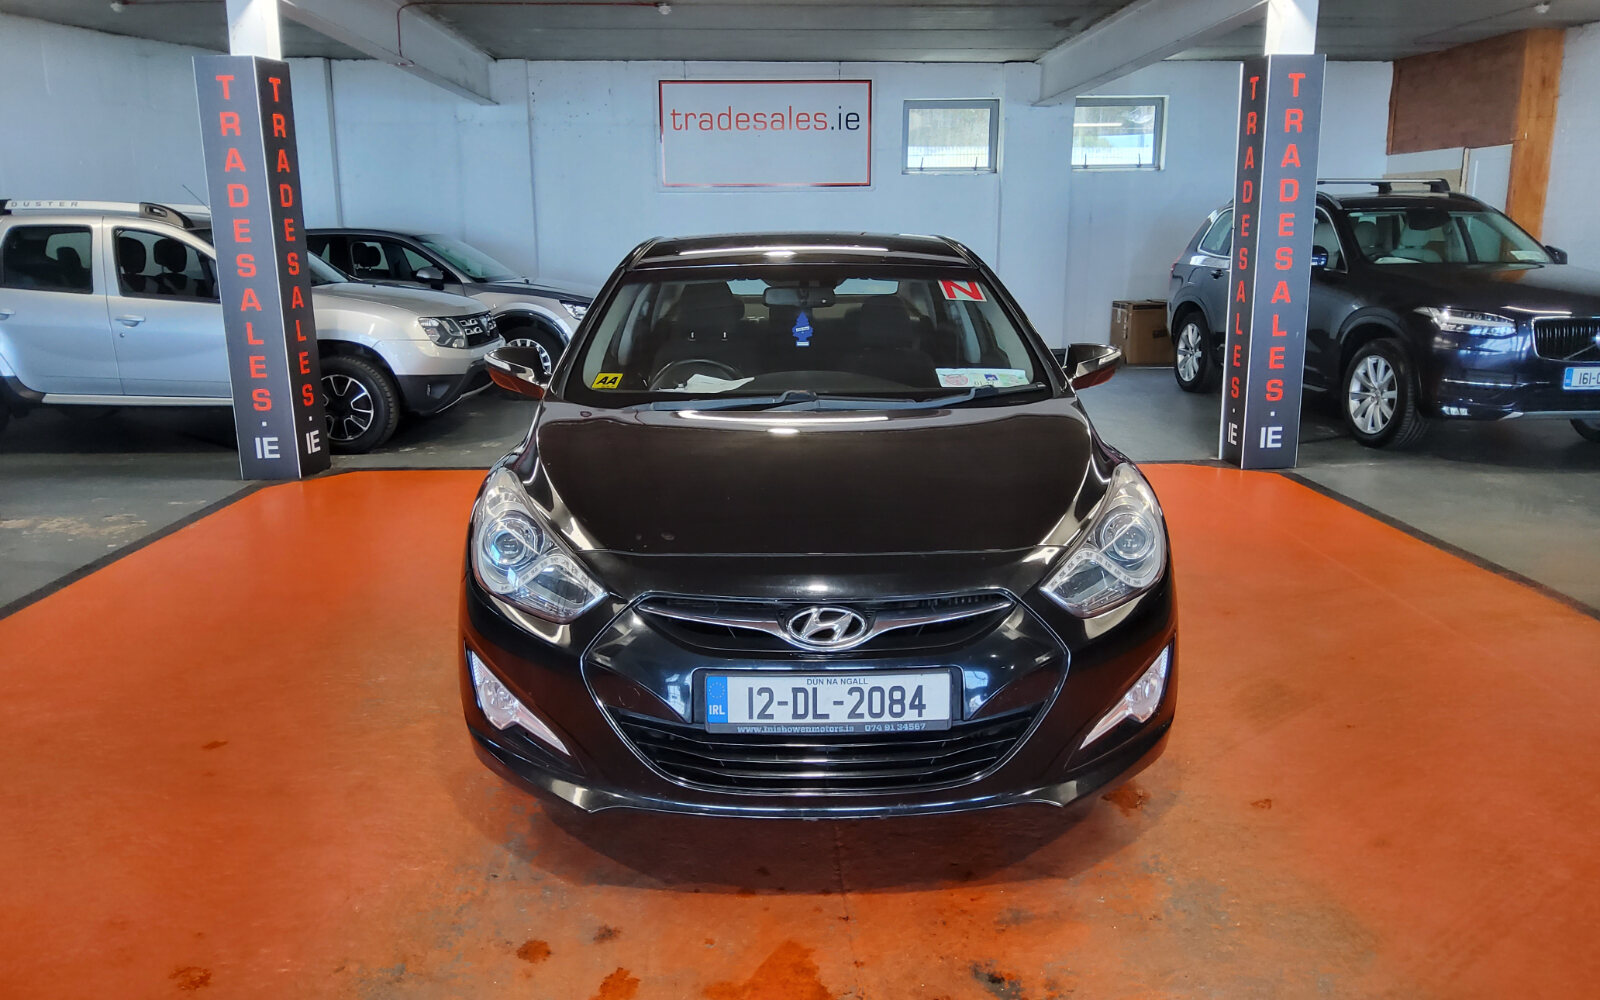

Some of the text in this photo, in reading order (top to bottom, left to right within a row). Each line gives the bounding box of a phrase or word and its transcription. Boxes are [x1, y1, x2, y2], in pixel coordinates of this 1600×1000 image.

[670, 106, 860, 131] tradesales.ie
[940, 280, 983, 300] N
[596, 376, 619, 384] AA
[826, 678, 838, 686] NA
[840, 677, 869, 686] NGALL
[747, 685, 926, 719] 12-DL-2084
[708, 705, 725, 715] IRL
[864, 724, 883, 732] 074
[885, 724, 895, 732] 91
